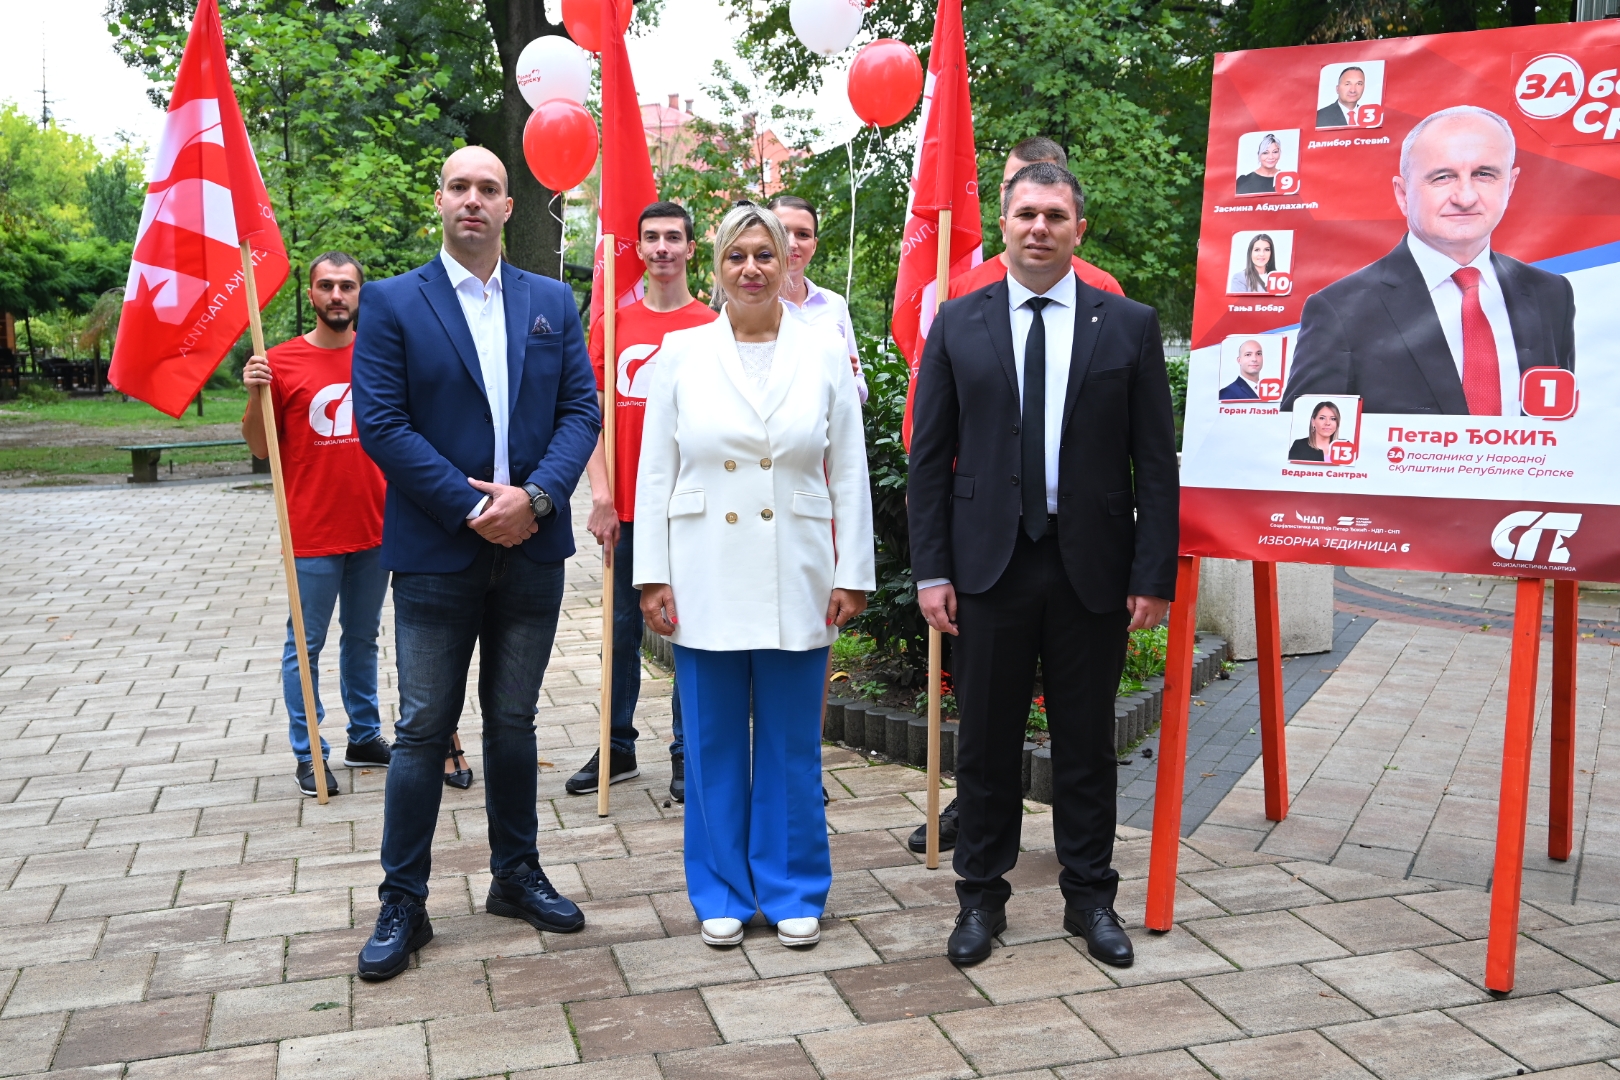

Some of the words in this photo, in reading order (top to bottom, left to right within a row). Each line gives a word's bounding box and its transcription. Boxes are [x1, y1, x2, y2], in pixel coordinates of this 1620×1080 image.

[1519, 71, 1577, 100] ЗА
[1588, 68, 1620, 98] б
[1363, 108, 1376, 123] 3
[1308, 138, 1352, 149] Далибор
[1353, 136, 1390, 146] Стевић
[1280, 175, 1294, 190] 9
[1213, 205, 1254, 213] Јасмина
[1255, 201, 1319, 212] Абдулахагић
[1268, 276, 1290, 291] 10
[1228, 304, 1253, 312] Тања
[1254, 304, 1285, 313] Бобар
[1260, 382, 1281, 397] 12
[1540, 379, 1557, 408] 1
[1219, 407, 1247, 415] Горан
[1249, 407, 1279, 415] Лазић
[1388, 427, 1459, 447] Петар
[1465, 428, 1557, 447] ЂОКИЋ
[1331, 446, 1353, 461] 13
[1388, 450, 1404, 459] ЗА
[1406, 452, 1474, 462] посланика
[1476, 454, 1484, 464] у
[1485, 453, 1547, 466] Народној
[1281, 468, 1324, 478] Ведрана
[1325, 470, 1368, 480] Сантрач
[1388, 464, 1455, 474] скупштини
[1458, 464, 1525, 476] Републике
[1527, 466, 1574, 478] Српске
[1258, 535, 1320, 548] ИЗБОРНА
[1322, 538, 1398, 553] ЈЕДИНИЦА
[1400, 543, 1411, 553] 6
[1492, 561, 1548, 570] СОЦИЈАЛИСТИЧКА
